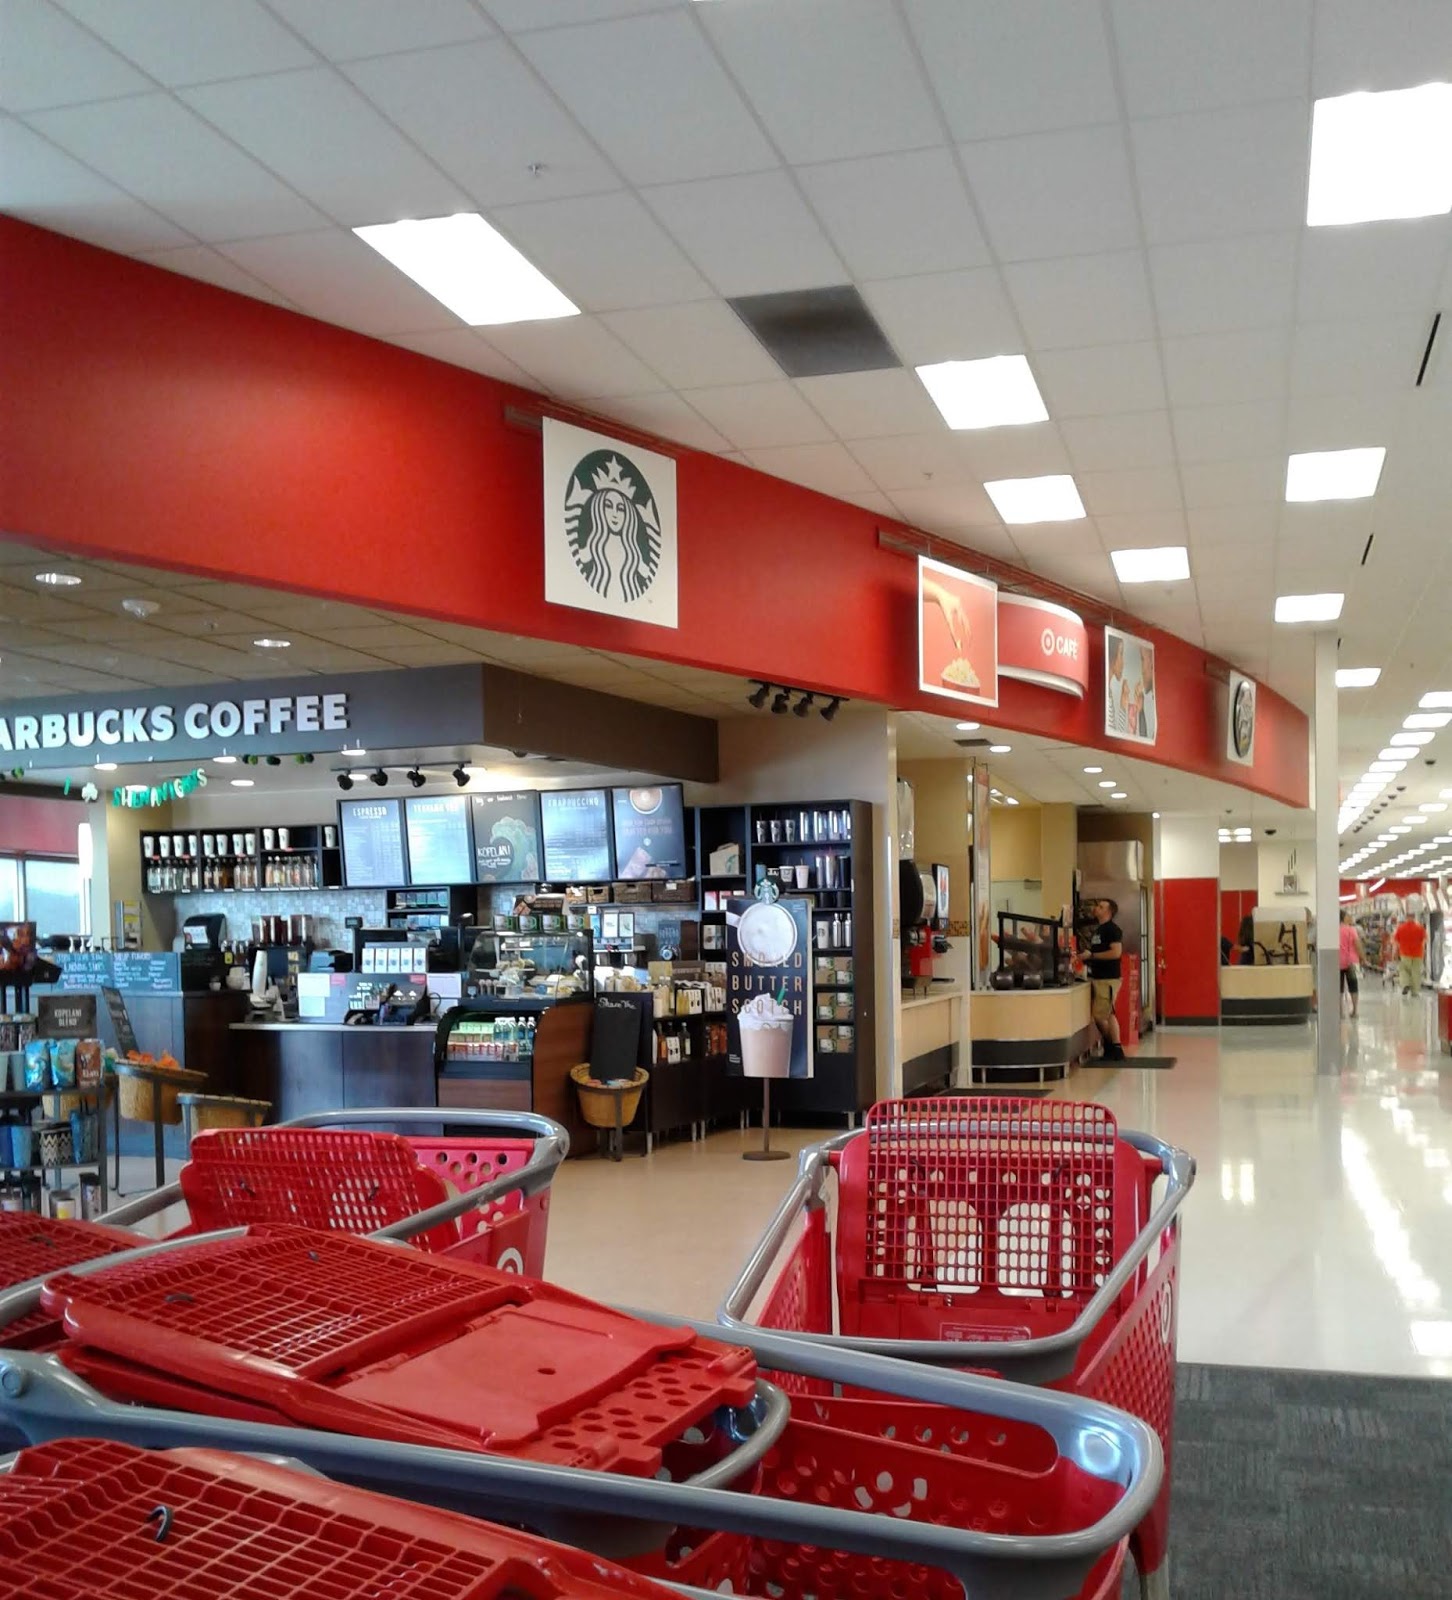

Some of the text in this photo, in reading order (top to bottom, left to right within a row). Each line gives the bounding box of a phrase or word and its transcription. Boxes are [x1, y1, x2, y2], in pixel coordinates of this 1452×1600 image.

[184, 693, 348, 739] COFFEE
[353, 806, 388, 817] ESPRESSO
[731, 975, 803, 992] BUTTER
[731, 998, 803, 1015] SCOTCH
